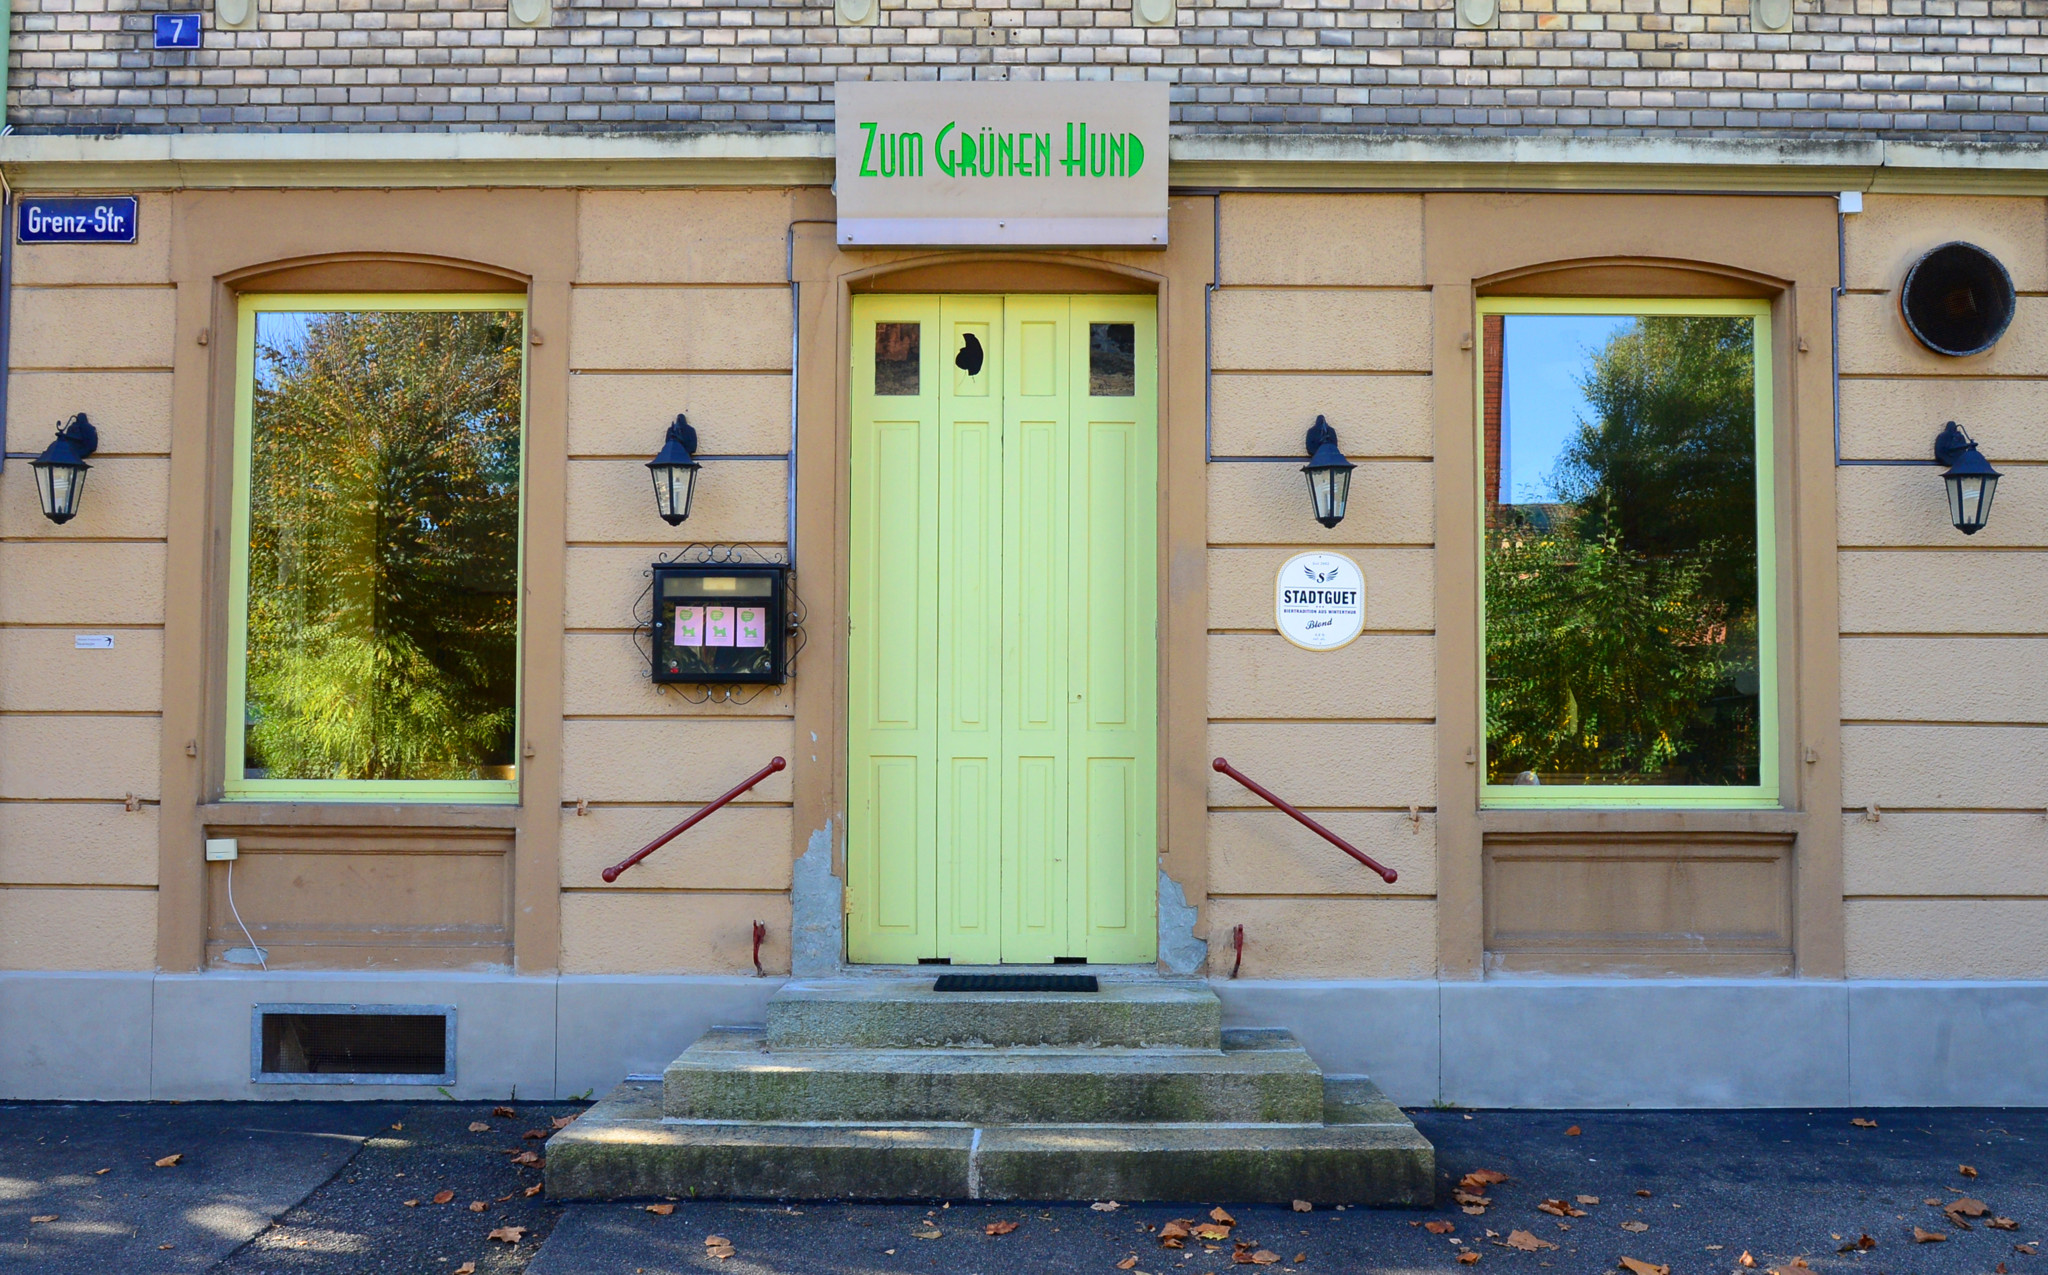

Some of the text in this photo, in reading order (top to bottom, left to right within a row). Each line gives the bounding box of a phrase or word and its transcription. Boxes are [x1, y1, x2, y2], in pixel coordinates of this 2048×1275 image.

[170, 19, 183, 43] 7
[934, 121, 1050, 178] GRÜNEN
[1059, 122, 1145, 178] HUND
[28, 206, 125, 233] Grenz-Str.
[1284, 590, 1357, 605] STADTGUET
